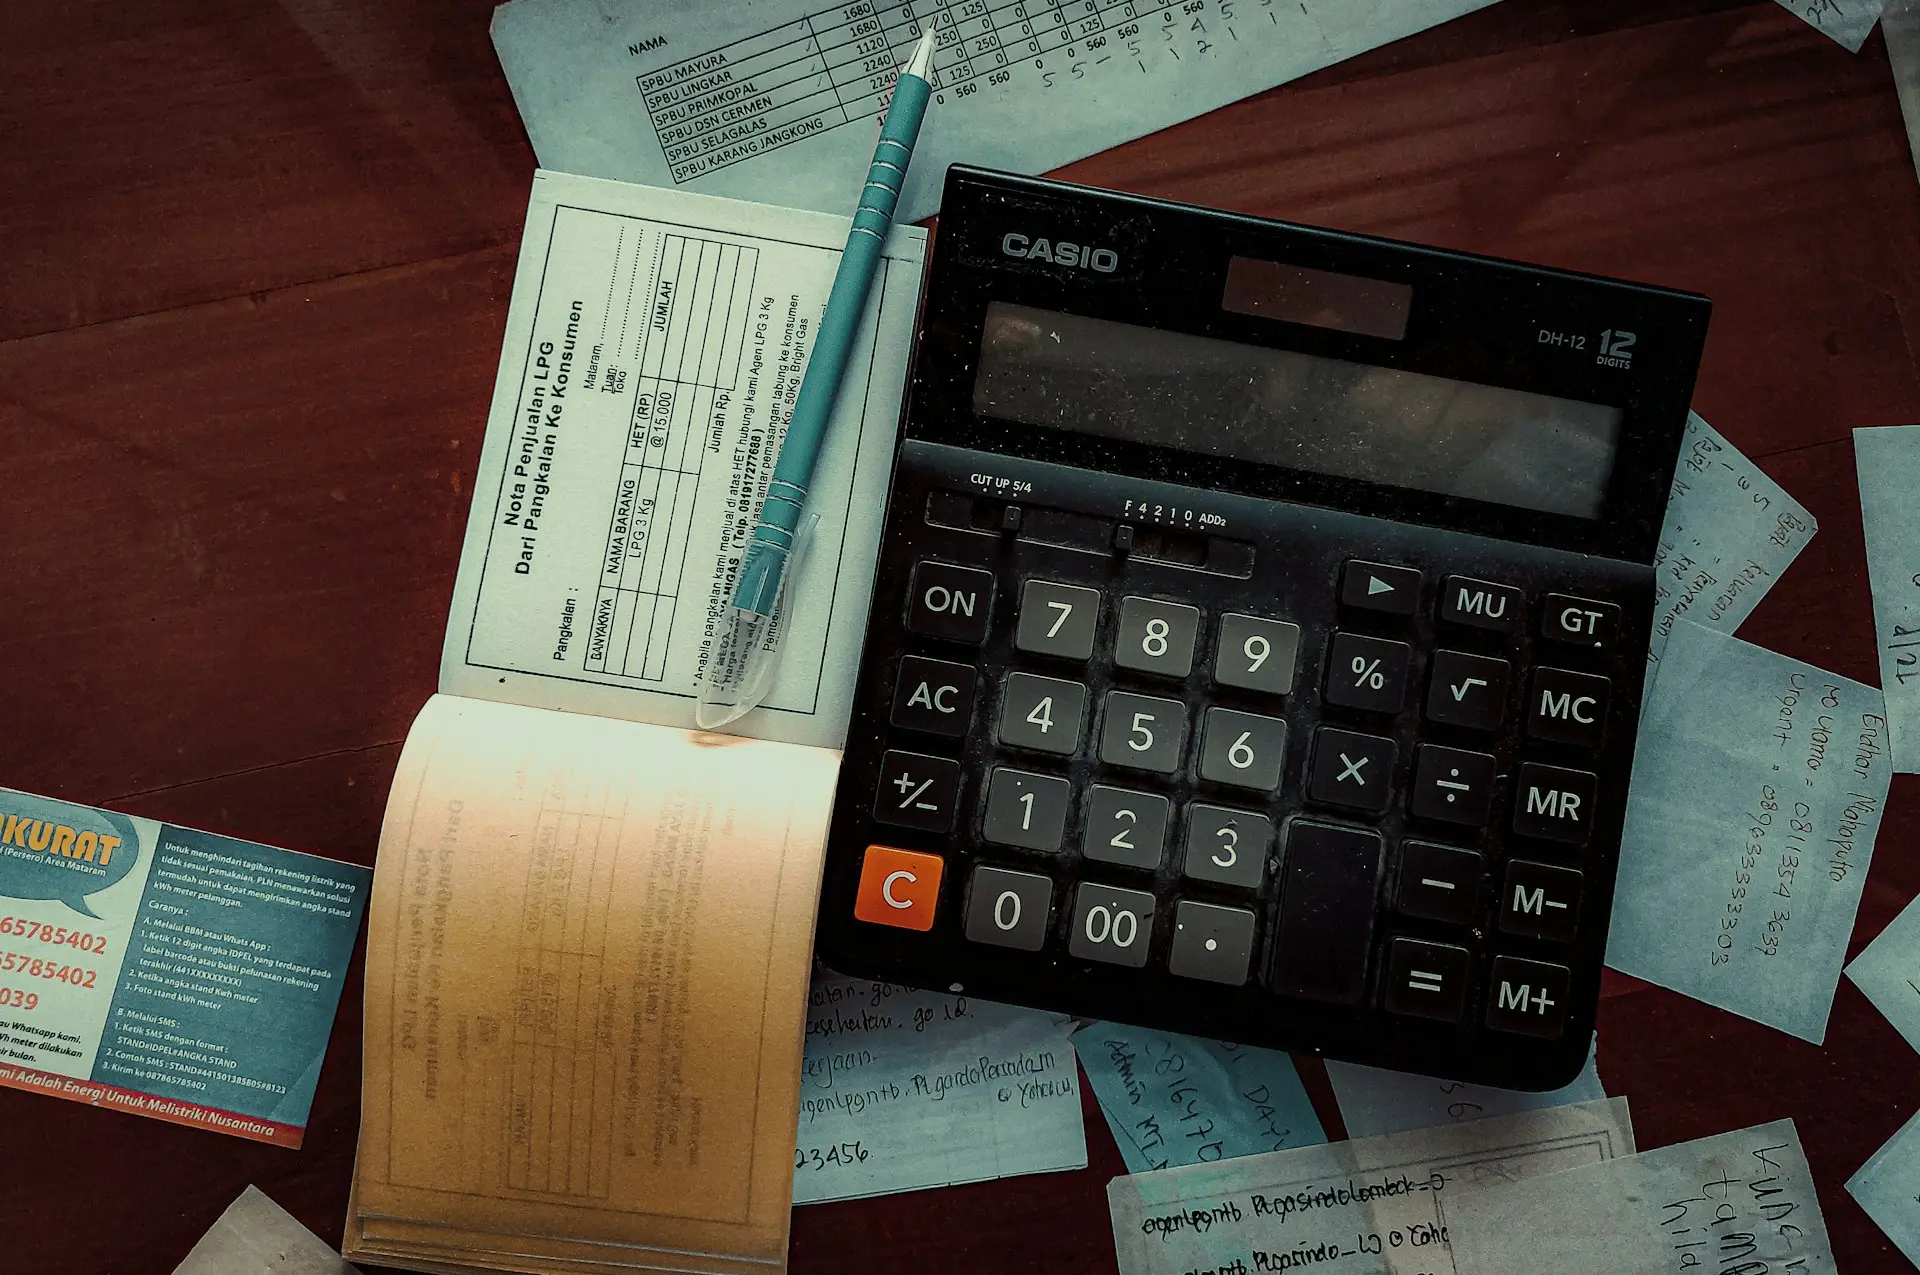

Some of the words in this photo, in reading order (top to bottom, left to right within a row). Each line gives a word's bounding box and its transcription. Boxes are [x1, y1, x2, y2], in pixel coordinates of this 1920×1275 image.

[962, 0, 984, 16] 125
[628, 35, 668, 56] NAMA
[641, 71, 672, 91] SPBU
[674, 53, 727, 79] MAYURA
[843, 3, 871, 20] 1680
[935, 30, 957, 46] 250
[949, 65, 970, 81] 125
[1080, 18, 1100, 34] 125
[955, 83, 977, 98] 560
[988, 70, 1010, 86] 560
[1086, 36, 1106, 51] 560
[1117, 24, 1139, 39] 560
[1183, 0, 1204, 15] 560
[975, 35, 997, 51] 250
[648, 89, 679, 108] SPBU
[680, 71, 733, 97] LINGKAR
[850, 20, 877, 37] 1680
[655, 106, 686, 126] SPBU
[687, 82, 758, 114] PRIMKOPAL
[856, 37, 884, 55] 1120
[661, 124, 692, 144] SPBU
[694, 114, 720, 132] DSN
[721, 96, 772, 121] CERMEN
[863, 54, 891, 72] 2240
[668, 142, 699, 161] SPBU
[701, 117, 767, 149] SELAGALAS
[869, 71, 898, 89] 2240
[675, 159, 706, 179] SPBU
[707, 141, 758, 167] KARANG
[760, 118, 823, 149] JANGKONG
[1002, 233, 1118, 275] CASIO
[654, 280, 673, 331] JUMLAH
[760, 297, 775, 310] Kg
[781, 294, 799, 347] konsumen
[754, 323, 767, 345] LPG
[796, 318, 808, 339] Gas
[1538, 329, 1585, 350] DH-12
[1600, 329, 1636, 360] 12
[534, 342, 554, 380] LPG
[550, 300, 583, 398] Konsumen
[583, 343, 604, 389] Mataram,
[749, 348, 763, 375] Agen
[778, 349, 790, 361] ke
[789, 341, 805, 372] Bright
[1596, 354, 1632, 369] DIGITS
[601, 364, 617, 394] Tuan:
[613, 371, 627, 394] Toko
[744, 376, 758, 401] kami
[772, 364, 794, 400] tabung
[784, 375, 801, 405] 50Kg,
[544, 404, 562, 427] Ke
[636, 393, 654, 419] (RP)
[653, 392, 672, 431] 15.000
[716, 391, 731, 409] Rp.
[514, 386, 546, 477] Penjualan
[630, 422, 646, 448] HET
[650, 435, 664, 447] @
[708, 413, 725, 453] Jumlah
[736, 403, 755, 447] hubungi
[762, 402, 782, 469] pemasangan
[732, 447, 745, 470] HET
[738, 435, 761, 512] 081917277688
[523, 434, 557, 530] Pangkalan
[729, 473, 741, 495] atas
[757, 470, 769, 498] antar
[971, 473, 993, 486] CUT
[995, 477, 1010, 488] UP
[1012, 480, 1033, 494] 5/4
[503, 483, 526, 525] Nota
[614, 480, 635, 533] BARANG
[726, 498, 736, 507] di
[1125, 500, 1132, 510] F
[1138, 503, 1147, 513] 4
[1154, 505, 1162, 516] 2
[1171, 508, 1175, 518] 1
[1184, 510, 1192, 521] 0
[628, 530, 645, 558] LPG
[637, 498, 655, 518] Kg
[720, 510, 736, 551] menjual
[733, 516, 749, 543] Telp.
[514, 536, 536, 574] Dari
[606, 536, 625, 573] NAMA
[712, 554, 726, 579] kami
[704, 582, 726, 637] pangkalan
[925, 586, 976, 616] ON
[1047, 601, 1072, 637] 7
[1457, 588, 1506, 617] MU
[553, 598, 576, 661] Pangkalan
[590, 598, 612, 663] BANYAKNYA
[1142, 619, 1169, 656] 8
[1561, 608, 1603, 634] GT
[1244, 636, 1270, 672] 9
[1352, 656, 1383, 689] %
[907, 682, 958, 713] AC
[1027, 697, 1053, 733] 4
[1540, 690, 1596, 723] MC
[1128, 713, 1154, 751] 5
[1228, 732, 1254, 768] 6
[1020, 793, 1034, 830] 1
[1527, 786, 1580, 821] MR
[1110, 810, 1136, 849] 2
[1211, 828, 1237, 867] 3
[4, 847, 44, 863] (Persero)
[44, 856, 65, 868] Area
[67, 861, 106, 877] Mataram
[165, 842, 189, 854] Untuk
[335, 882, 355, 893] yang
[153, 881, 172, 891] kWh
[173, 887, 198, 897] meter
[883, 871, 916, 908] C
[995, 891, 1021, 930] 0
[1086, 906, 1137, 947] 00
[133, 984, 152, 994] Foto
[153, 990, 177, 1000] stand
[197, 999, 221, 1010] meter
[1498, 981, 1554, 1015] M+
[10, 1037, 38, 1048] meter
[38, 1042, 82, 1058] dilakukan
[11, 1022, 56, 1039] Whatsapp
[56, 1031, 81, 1044] kami.
[8, 1049, 36, 1062] bulan.
[15, 1071, 62, 1090] Adalah
[63, 1081, 106, 1103] Energi
[106, 1090, 145, 1108] Untuk
[146, 1099, 208, 1121] Melistriki
[207, 1111, 274, 1136] Nusantara
